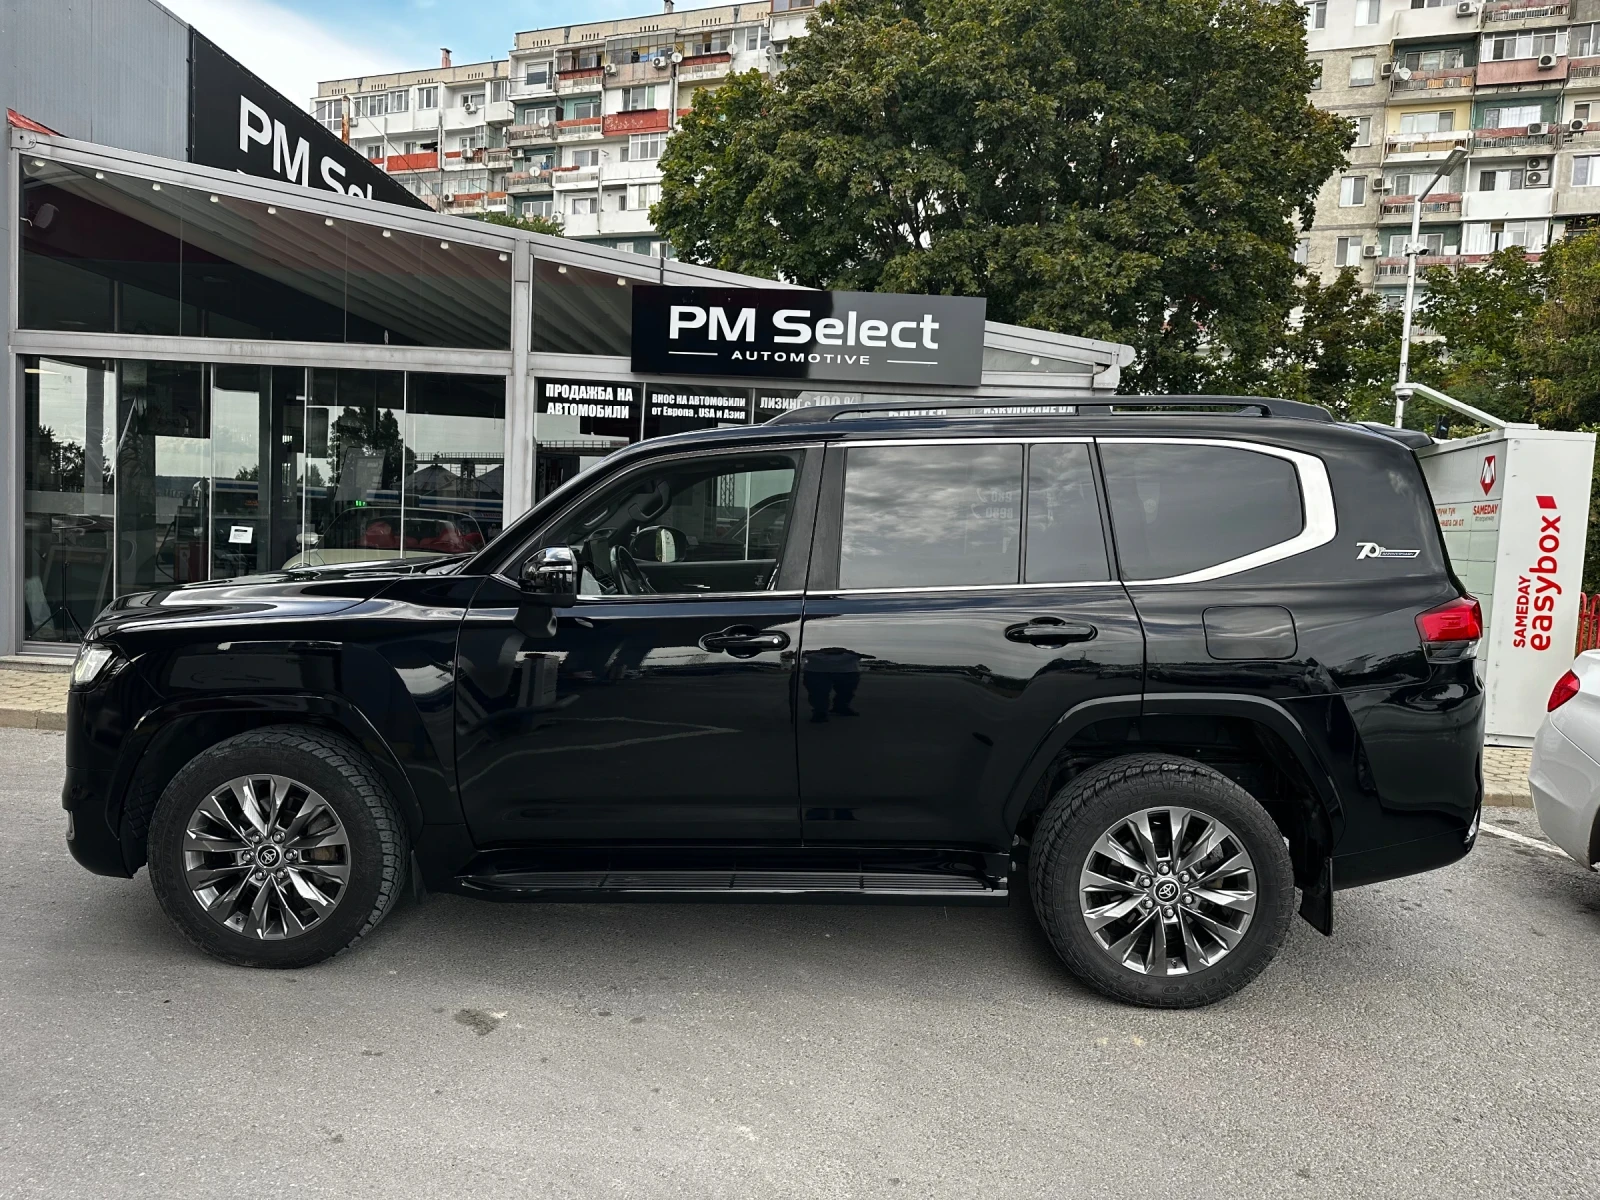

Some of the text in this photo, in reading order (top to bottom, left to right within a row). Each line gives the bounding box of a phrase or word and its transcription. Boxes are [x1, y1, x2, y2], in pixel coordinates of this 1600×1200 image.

[240, 95, 310, 187] PM
[669, 305, 940, 350] PM Select
[731, 350, 870, 365] AUTOMOTIVE
[546, 384, 633, 402] ПРОДАЖБА НА
[652, 393, 746, 407] ВНОС НА АВТОМОБИЛИ
[547, 402, 630, 419] АВТОМОБИЛИ
[760, 396, 803, 410] ЛИЗИНГ
[651, 407, 662, 415] от
[663, 406, 694, 417] Европа
[699, 407, 715, 418] USA
[716, 410, 722, 418] и
[723, 409, 746, 419] Азия
[1473, 504, 1499, 515] SAMEDAY
[1529, 515, 1562, 651] easybox
[1513, 575, 1531, 648] SAMEDAY
